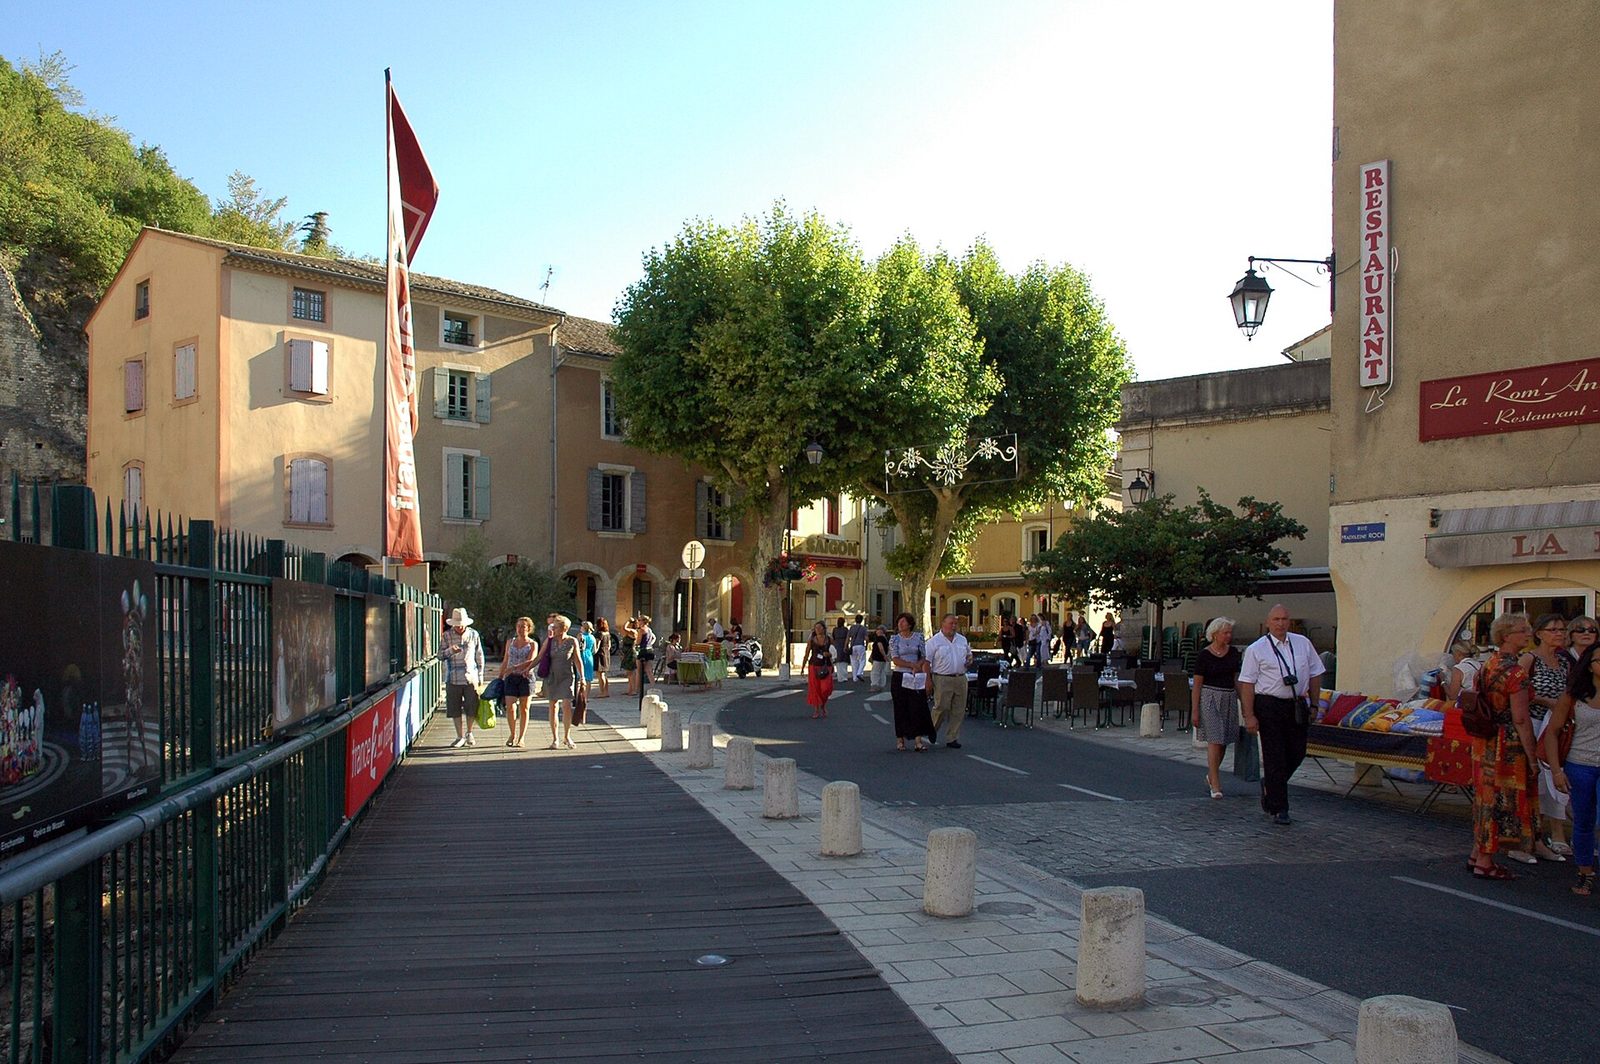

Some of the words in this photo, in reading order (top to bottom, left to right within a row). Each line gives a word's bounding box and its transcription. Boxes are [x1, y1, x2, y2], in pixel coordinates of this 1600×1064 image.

[1364, 168, 1384, 379] RESTAURANT
[1430, 385, 1468, 410] La
[1495, 405, 1587, 425] Restaurant
[807, 537, 858, 556] SAIGON
[1512, 532, 1568, 557] LA
